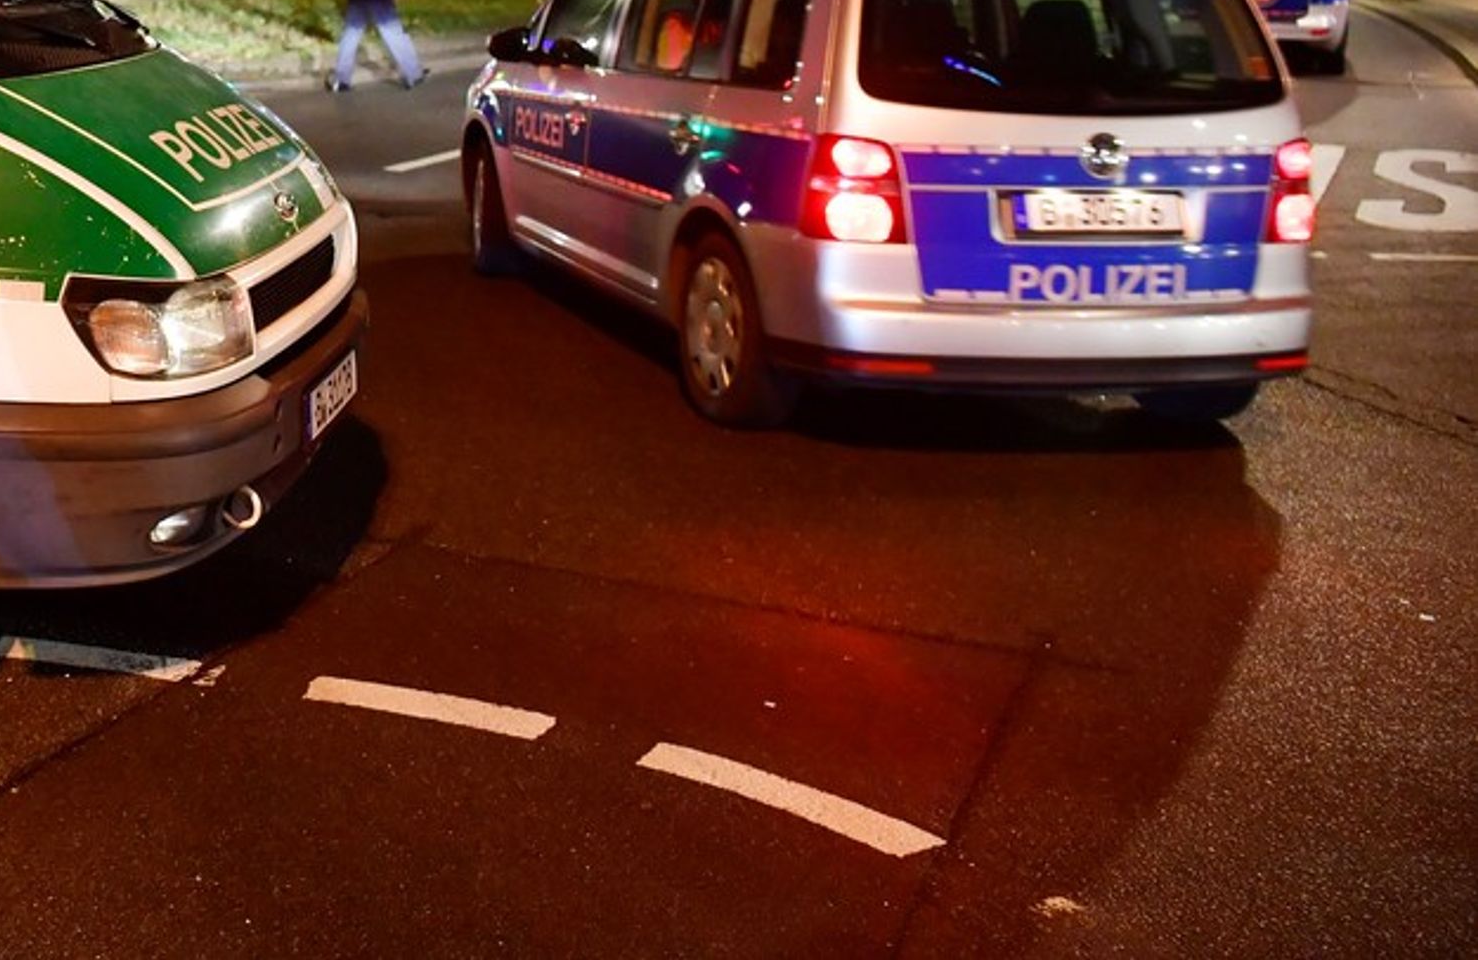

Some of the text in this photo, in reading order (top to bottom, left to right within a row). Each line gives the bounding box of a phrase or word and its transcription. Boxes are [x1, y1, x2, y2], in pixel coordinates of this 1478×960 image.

[149, 103, 285, 182] POLIZEI
[515, 106, 564, 149] POLIZEI
[1009, 264, 1188, 305] POLIZEI
